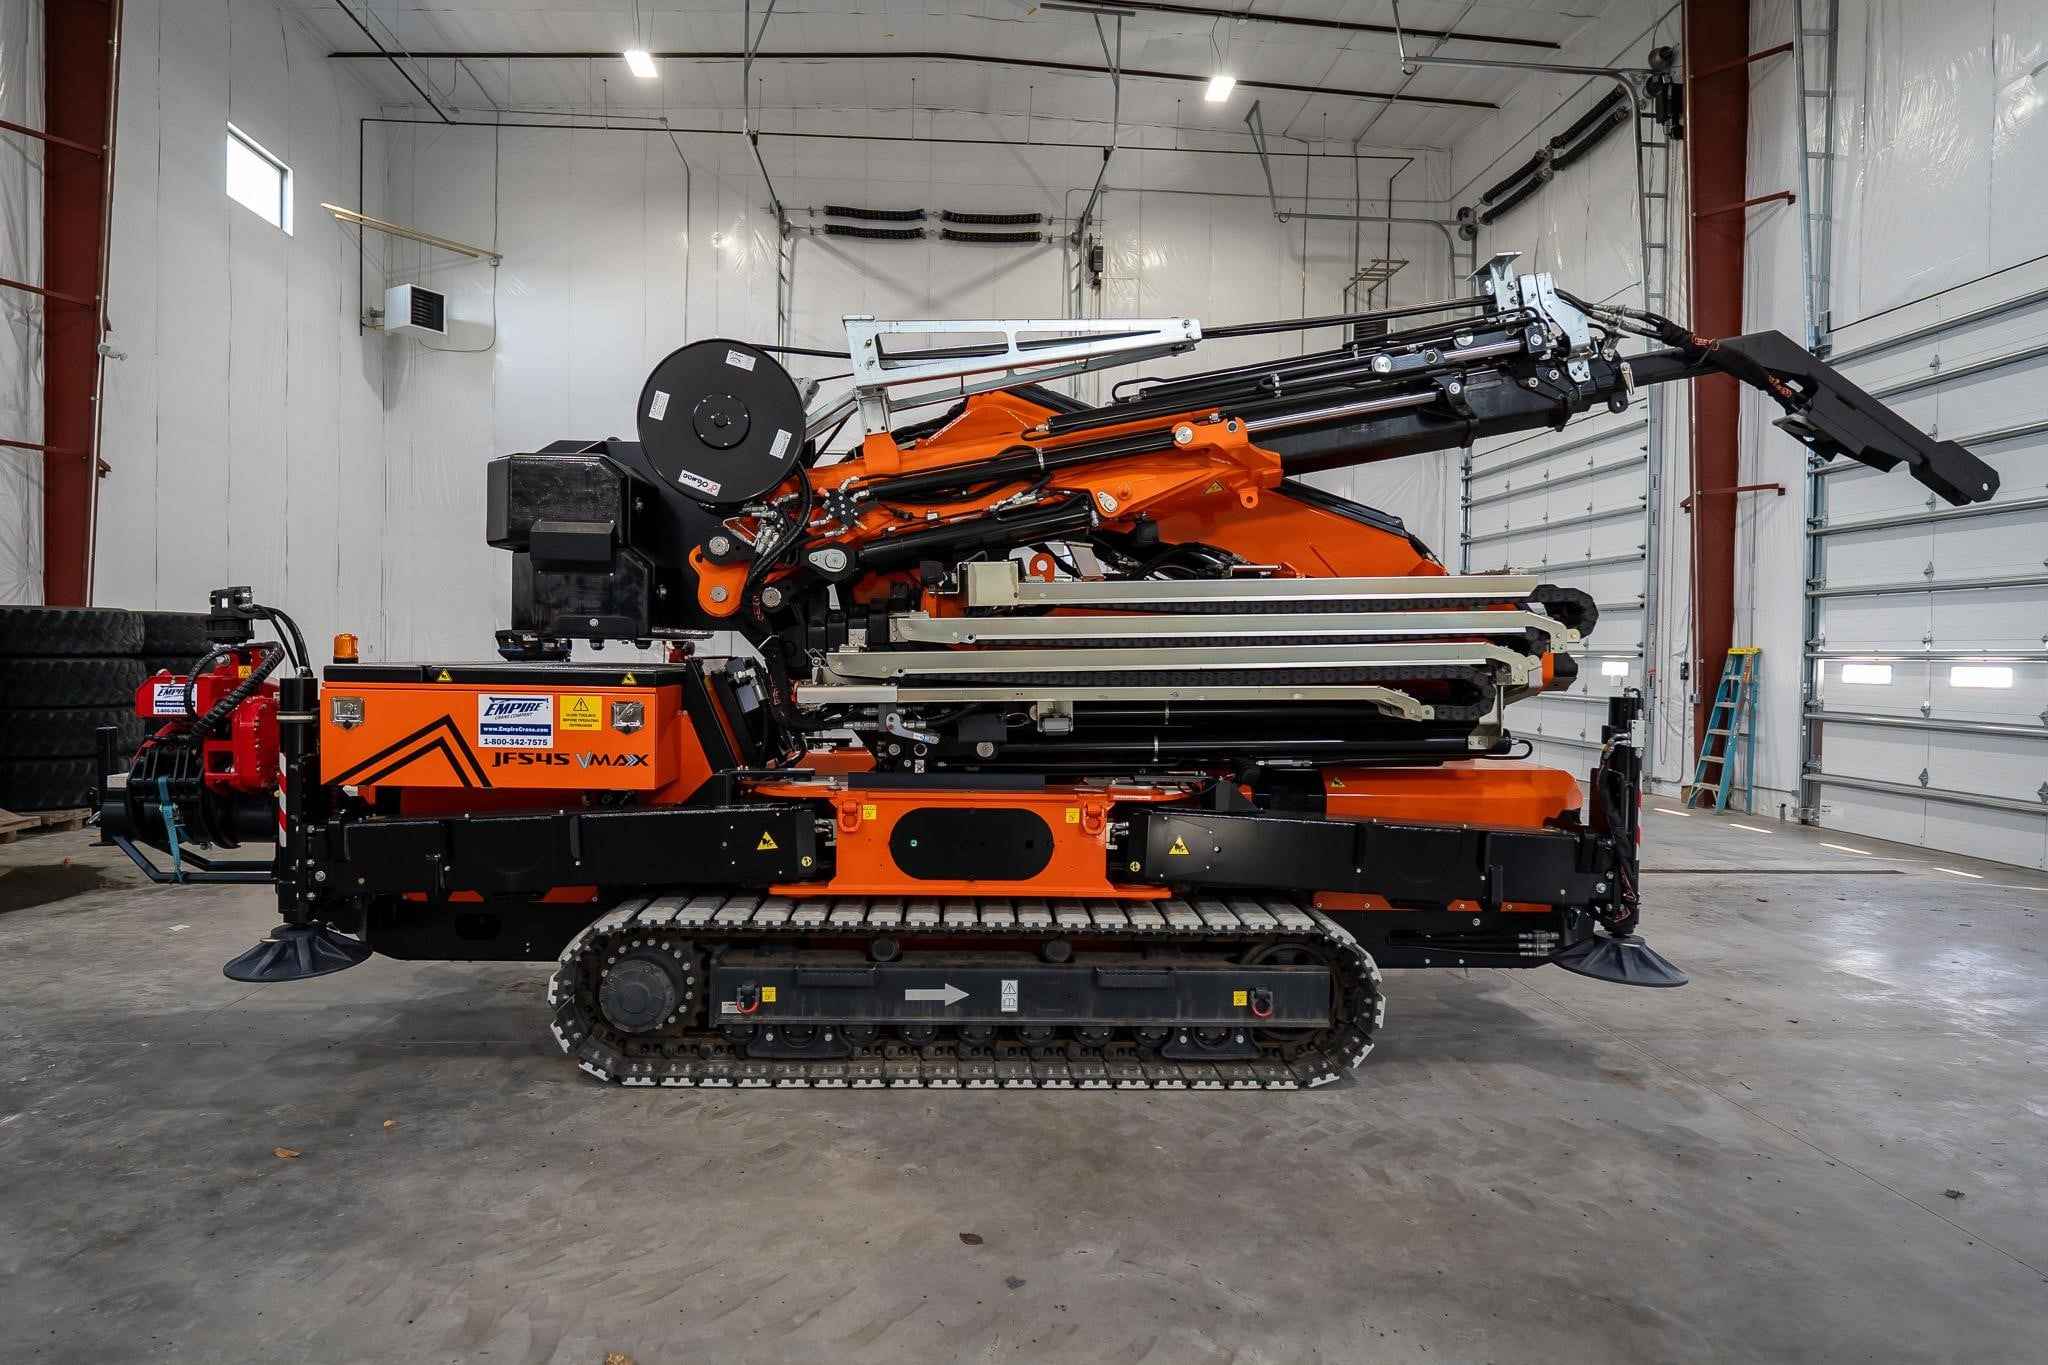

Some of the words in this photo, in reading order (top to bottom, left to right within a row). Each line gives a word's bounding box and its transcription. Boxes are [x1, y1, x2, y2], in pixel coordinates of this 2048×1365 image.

[157, 688, 185, 697] EMPI
[483, 702, 543, 717] EMPIRE
[483, 725, 549, 734] www.EmpireCrane.com
[483, 738, 548, 746] 1-800-342-7575
